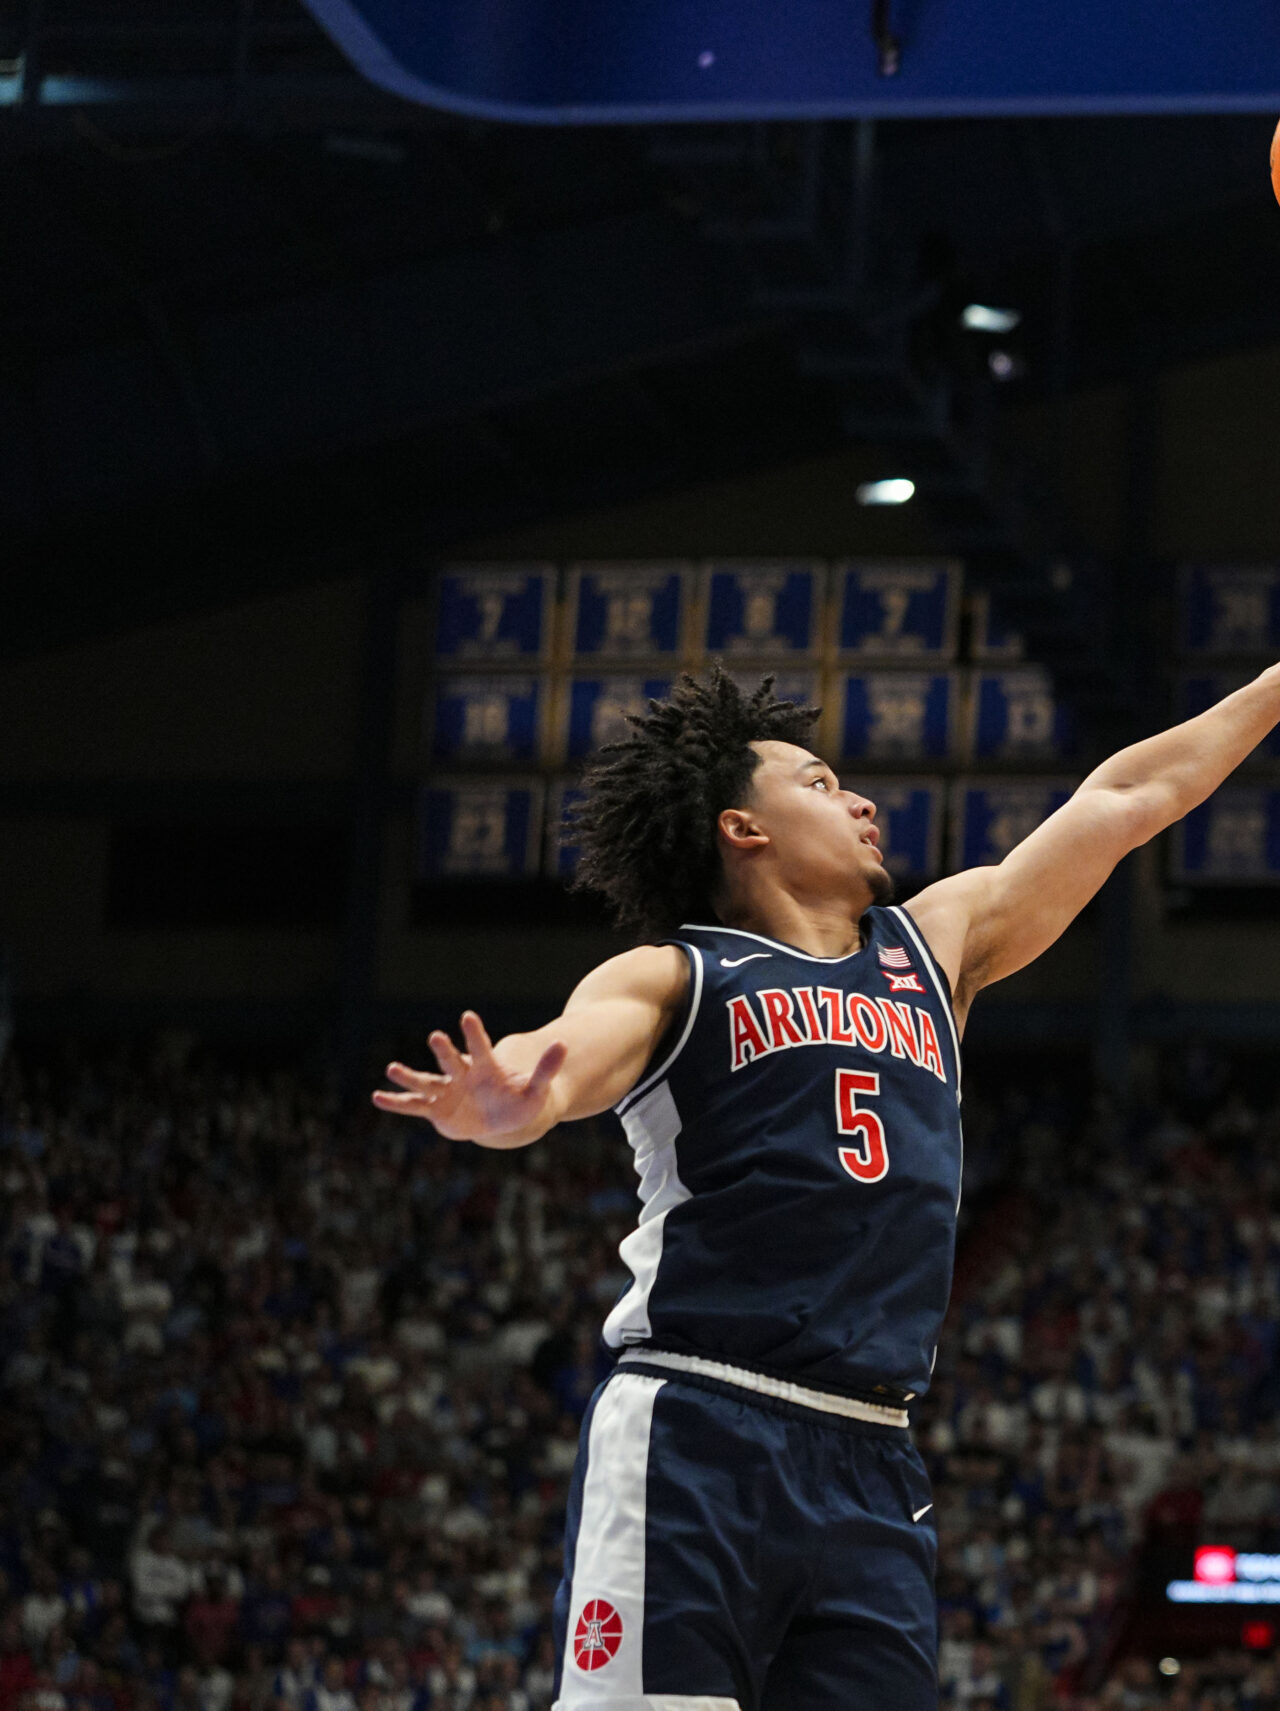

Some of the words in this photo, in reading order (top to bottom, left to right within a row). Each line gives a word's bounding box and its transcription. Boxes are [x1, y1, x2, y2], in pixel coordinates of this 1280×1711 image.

[726, 986, 947, 1083] ARIZONA
[835, 1068, 889, 1184] 5
[583, 1621, 604, 1649] A
